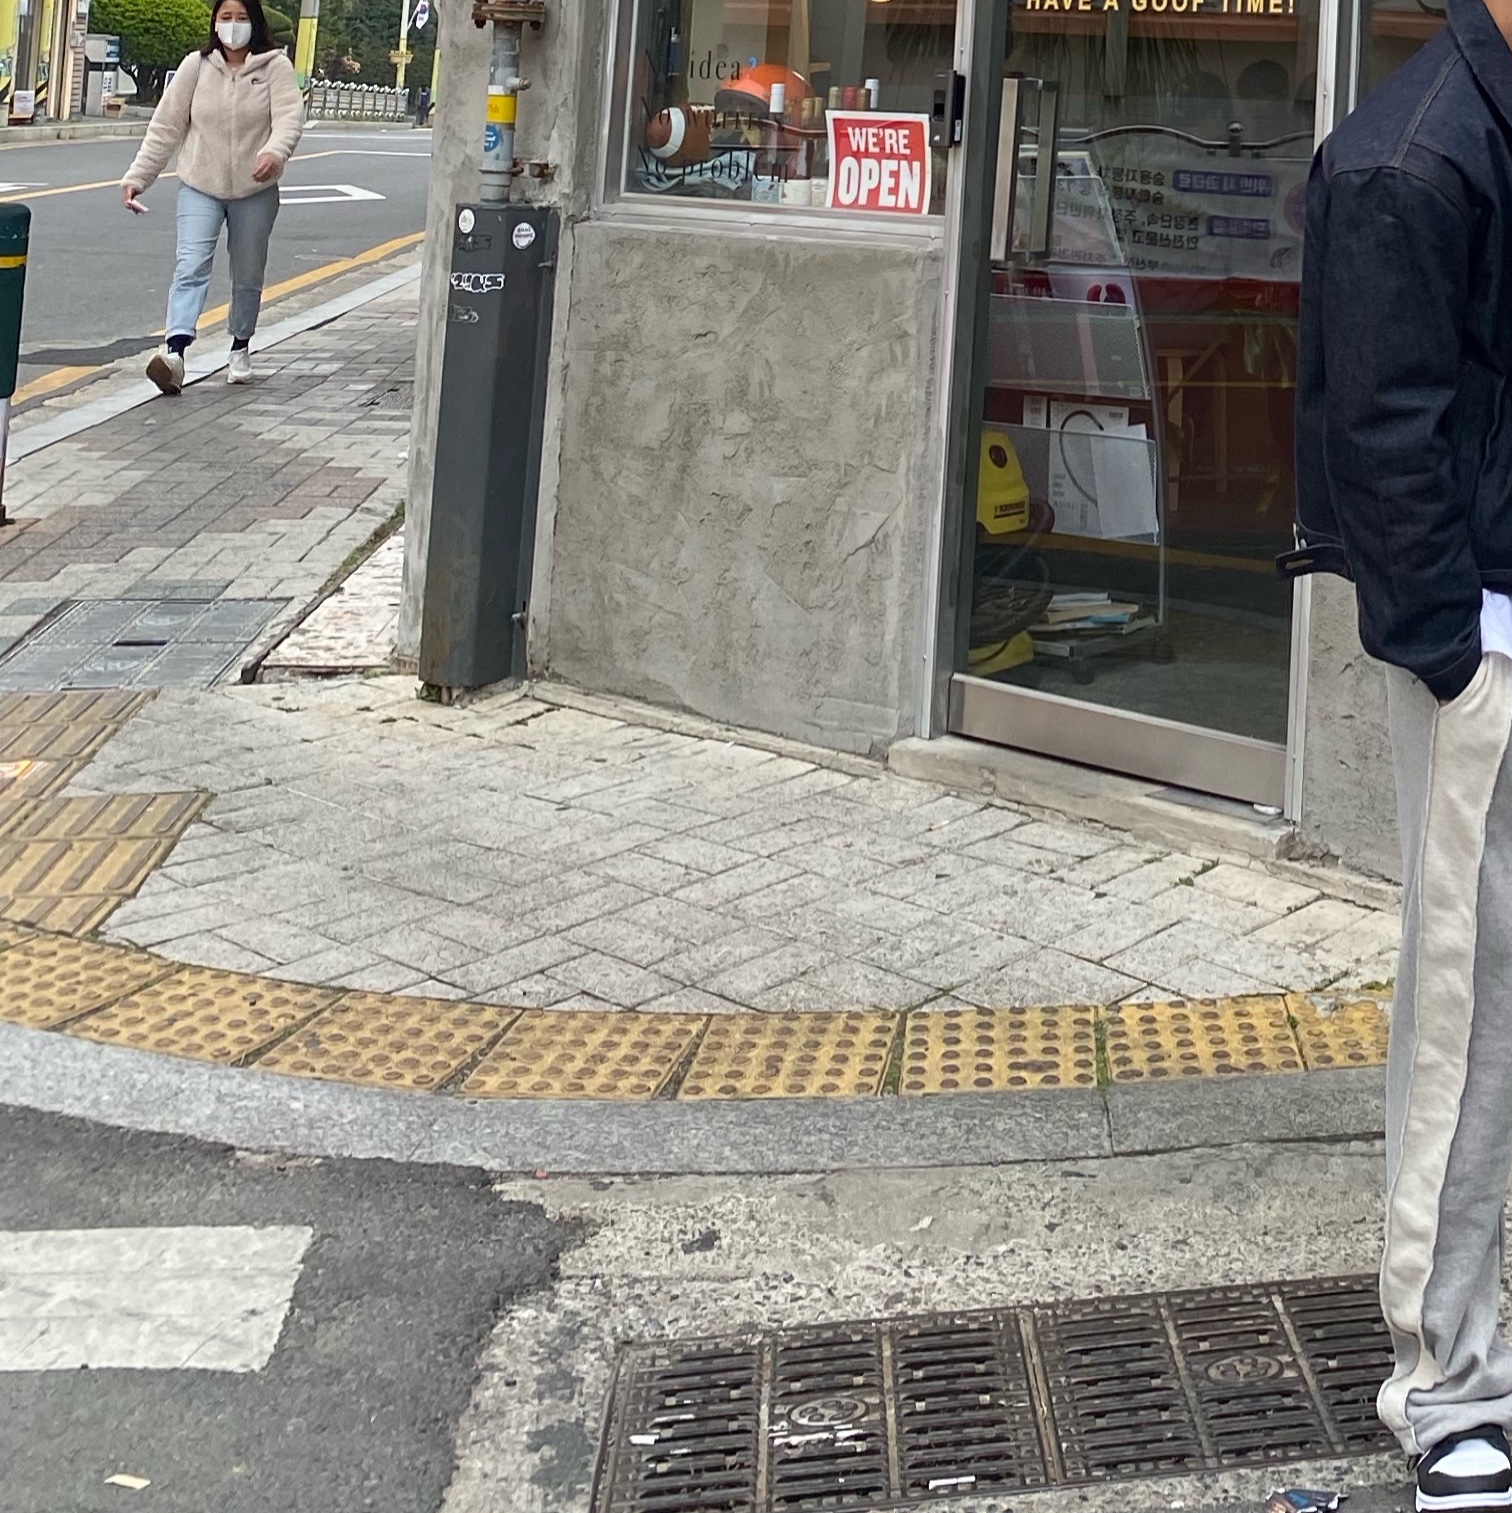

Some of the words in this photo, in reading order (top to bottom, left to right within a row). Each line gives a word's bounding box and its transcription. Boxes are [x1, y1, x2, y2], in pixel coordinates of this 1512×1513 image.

[689, 50, 741, 81] idea
[682, 150, 789, 187] problem
[837, 157, 922, 210] OPEN
